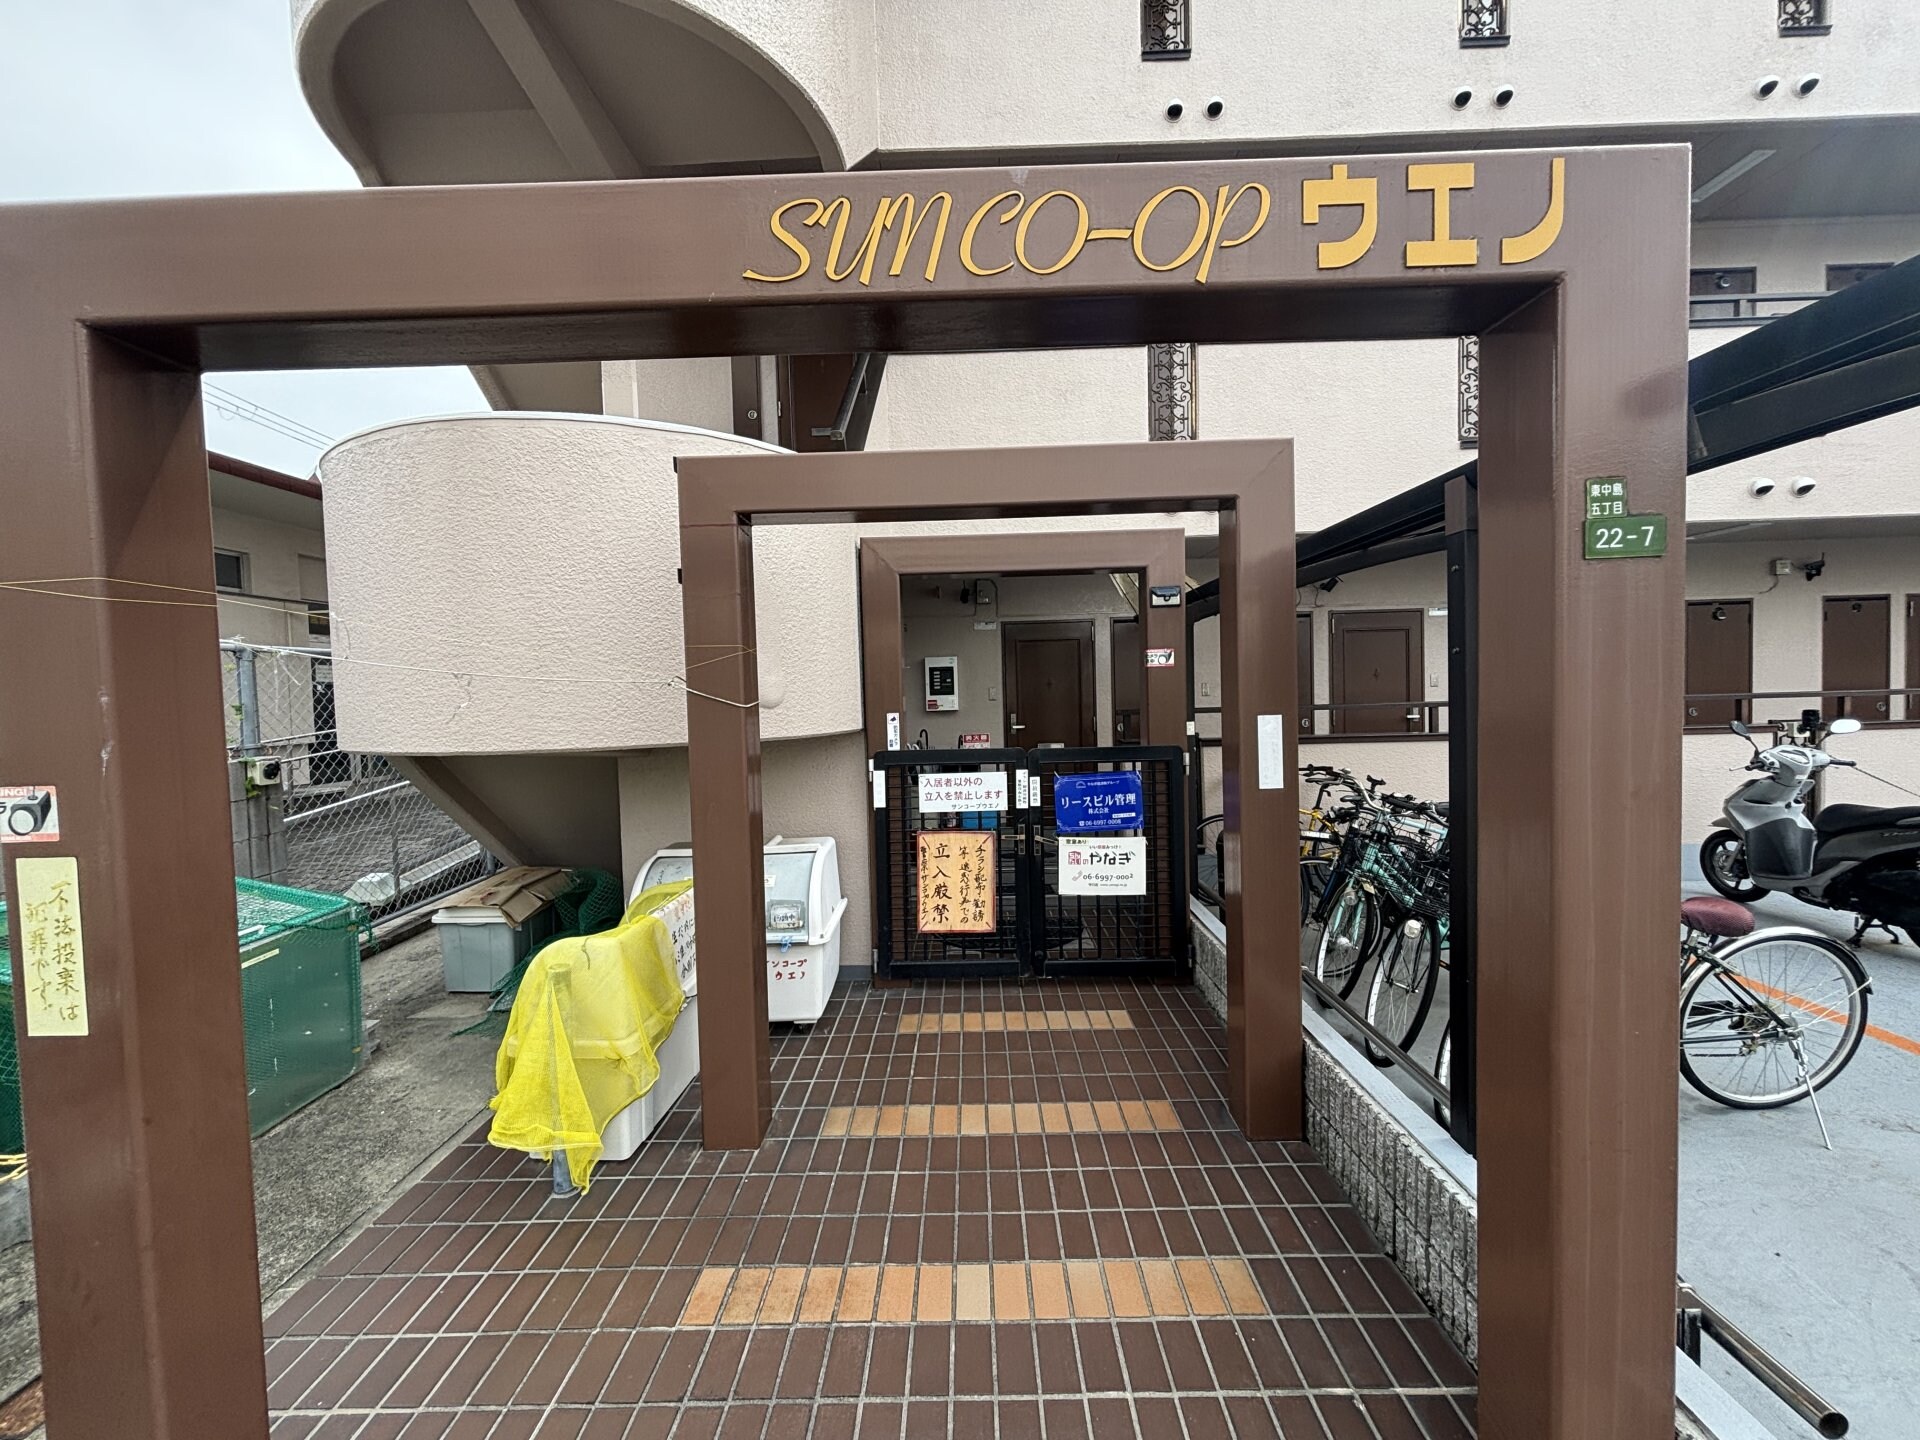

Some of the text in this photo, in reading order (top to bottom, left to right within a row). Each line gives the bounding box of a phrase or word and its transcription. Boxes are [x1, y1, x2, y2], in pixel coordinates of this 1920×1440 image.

[1302, 156, 1566, 269] ウエノ
[1591, 482, 1623, 497] 東中島
[1592, 501, 1622, 515] 五丁目
[1596, 526, 1654, 548] 22-7
[924, 777, 983, 787] 入居者以外の
[924, 790, 1003, 801] 立入を禁止します
[1061, 793, 1137, 808] リースビル管理
[931, 843, 952, 923] 立入厳禁
[49, 880, 80, 1021] 不法投棄は
[766, 959, 808, 968] ンコープ
[775, 971, 806, 980] ウエノ
